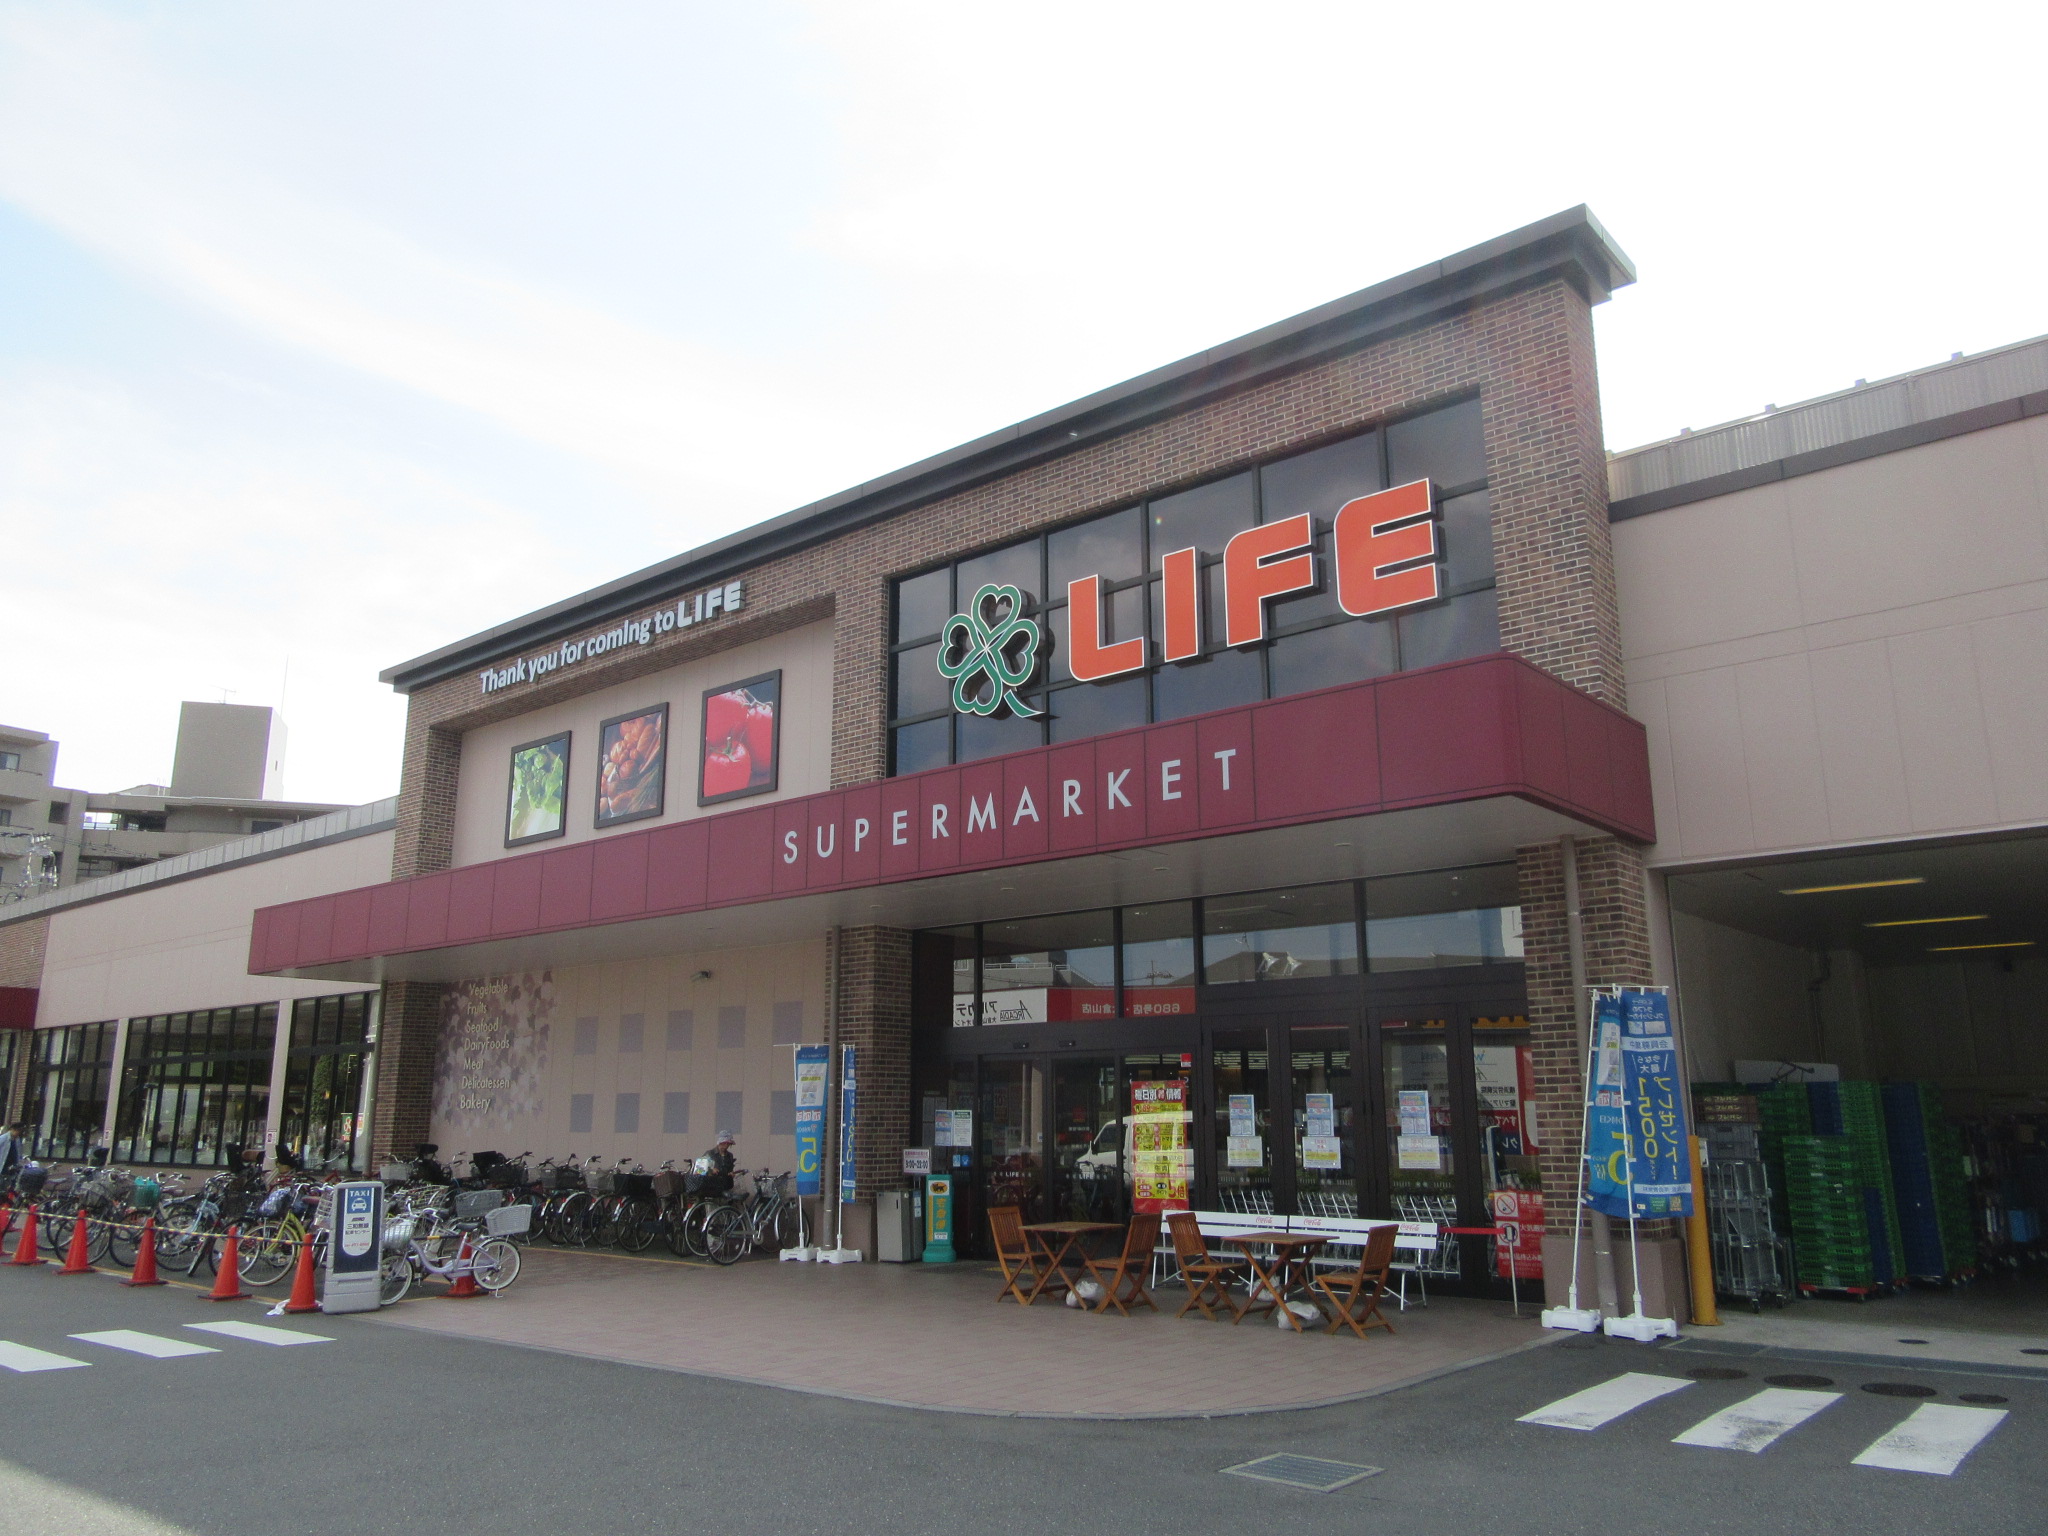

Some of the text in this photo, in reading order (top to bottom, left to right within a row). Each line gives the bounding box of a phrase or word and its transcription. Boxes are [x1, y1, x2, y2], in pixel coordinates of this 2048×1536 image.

[1068, 477, 1440, 682] LIFE
[480, 580, 744, 693] Thank you for coming to LIFE
[783, 748, 1237, 864] SUPERMARKET
[469, 979, 509, 999] Vegetable
[467, 1001, 488, 1015] Fruits
[466, 1017, 499, 1033] Seafood
[463, 1057, 484, 1070] Meat
[461, 1075, 510, 1090] Delicatessen
[460, 1092, 491, 1114] Bakery
